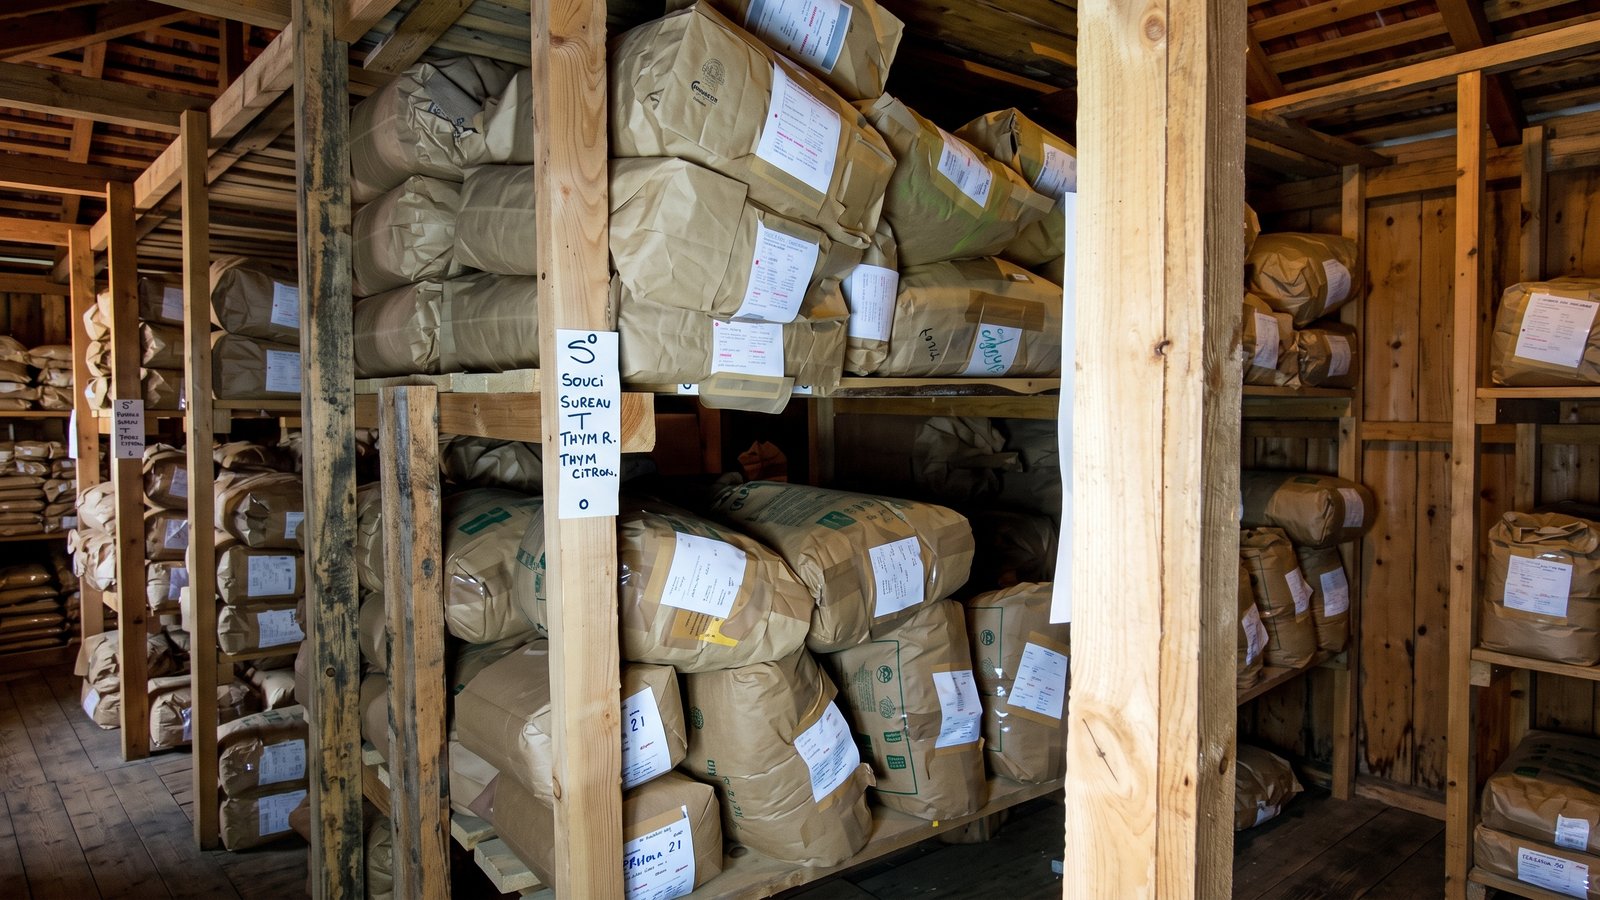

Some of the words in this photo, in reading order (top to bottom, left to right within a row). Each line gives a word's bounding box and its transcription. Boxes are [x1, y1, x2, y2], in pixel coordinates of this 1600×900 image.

[560, 395, 611, 409] SUREAU
[568, 412, 592, 430] T
[560, 431, 598, 447] THYM
[559, 453, 597, 467] THYM
[631, 716, 644, 732] 21
[669, 840, 681, 853] 21
